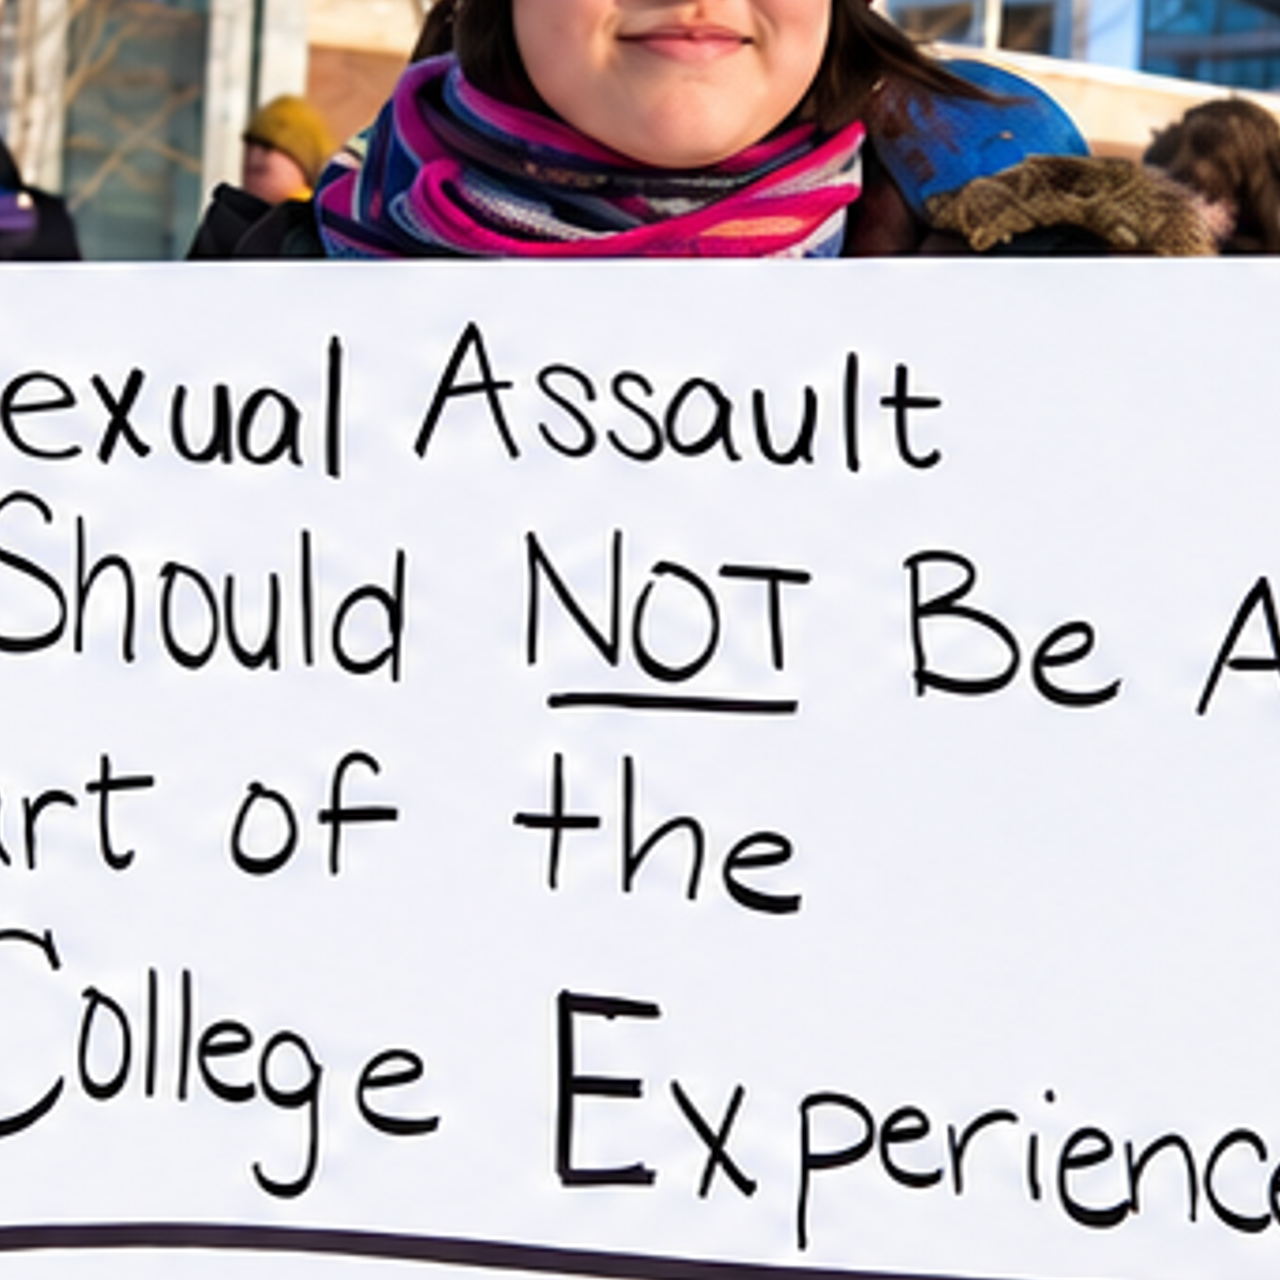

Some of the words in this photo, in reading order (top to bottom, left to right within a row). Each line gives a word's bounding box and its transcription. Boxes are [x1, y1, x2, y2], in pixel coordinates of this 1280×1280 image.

[415, 323, 942, 472] Assault
[526, 530, 811, 682] NOT
[904, 550, 1122, 707] Be
[231, 752, 399, 875] of
[514, 753, 802, 915] the
